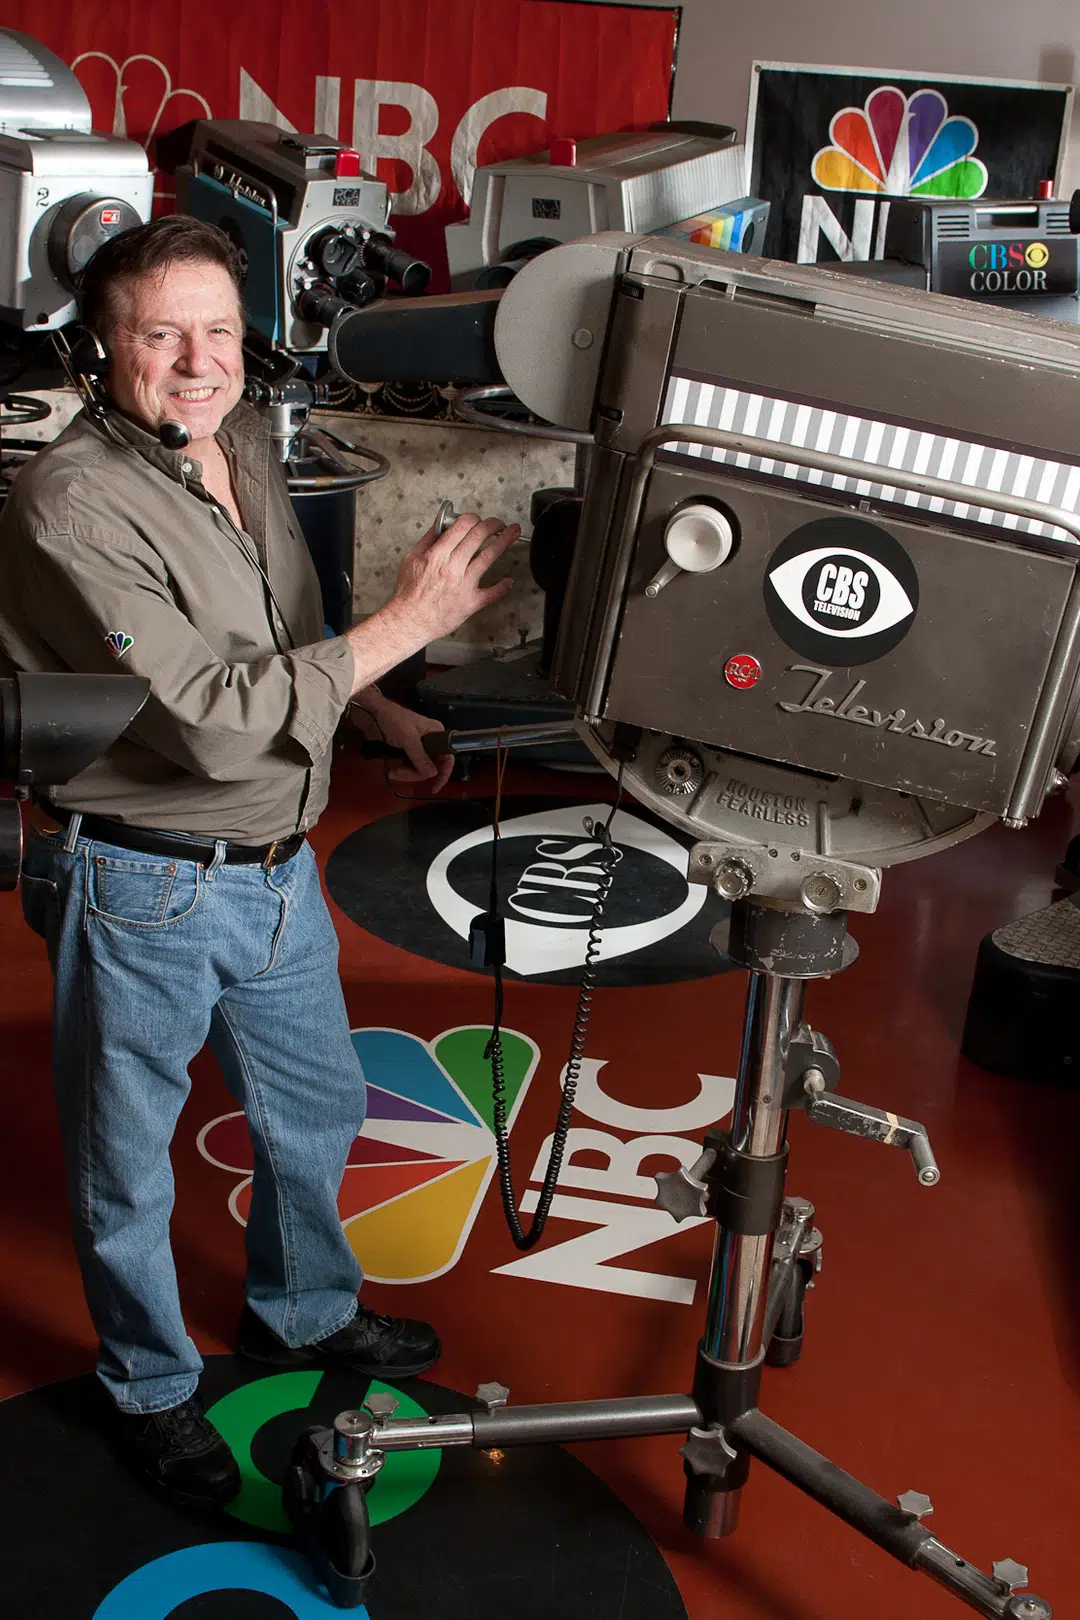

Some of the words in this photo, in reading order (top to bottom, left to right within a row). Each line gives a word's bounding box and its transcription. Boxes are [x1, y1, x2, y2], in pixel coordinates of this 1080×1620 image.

[240, 66, 548, 216] NBC
[36, 187, 50, 207] 2
[335, 188, 360, 201] RCA
[969, 243, 1025, 270] CBS
[970, 270, 1048, 292] COLOR
[816, 563, 869, 610] CBS
[813, 600, 861, 622] TELEVISION
[725, 661, 760, 680] RCA
[779, 664, 997, 757] Television
[716, 792, 810, 828] FEARLESS
[725, 778, 808, 813] HOUSTON
[508, 839, 624, 924] CBS
[489, 1057, 737, 1305] NBC
